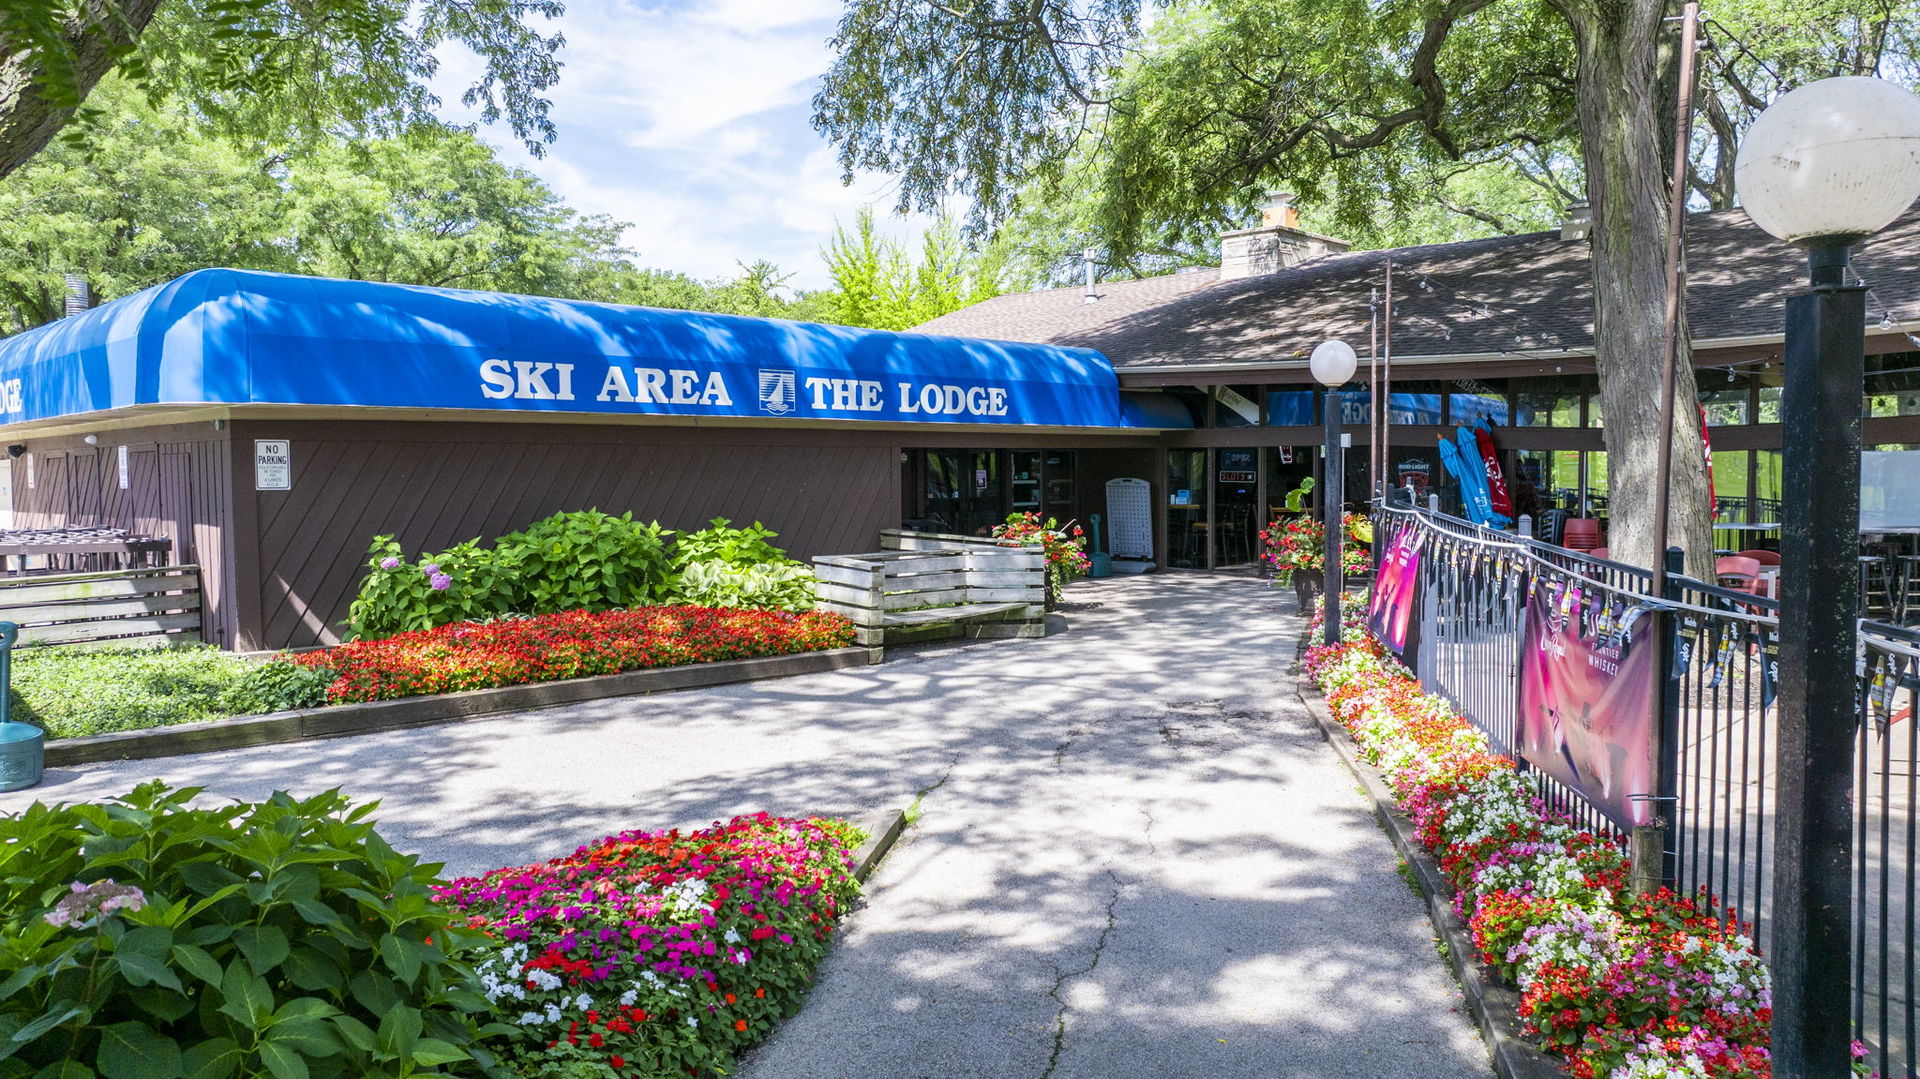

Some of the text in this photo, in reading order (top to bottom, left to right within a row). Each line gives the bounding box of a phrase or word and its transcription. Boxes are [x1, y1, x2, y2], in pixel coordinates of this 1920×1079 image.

[480, 359, 1009, 416] SKI AREA THE LODGE
[265, 444, 279, 455] NO
[258, 455, 287, 465] PARKING
[1221, 472, 1246, 481] SLOTS
[1587, 654, 1620, 677] WHISKEY
